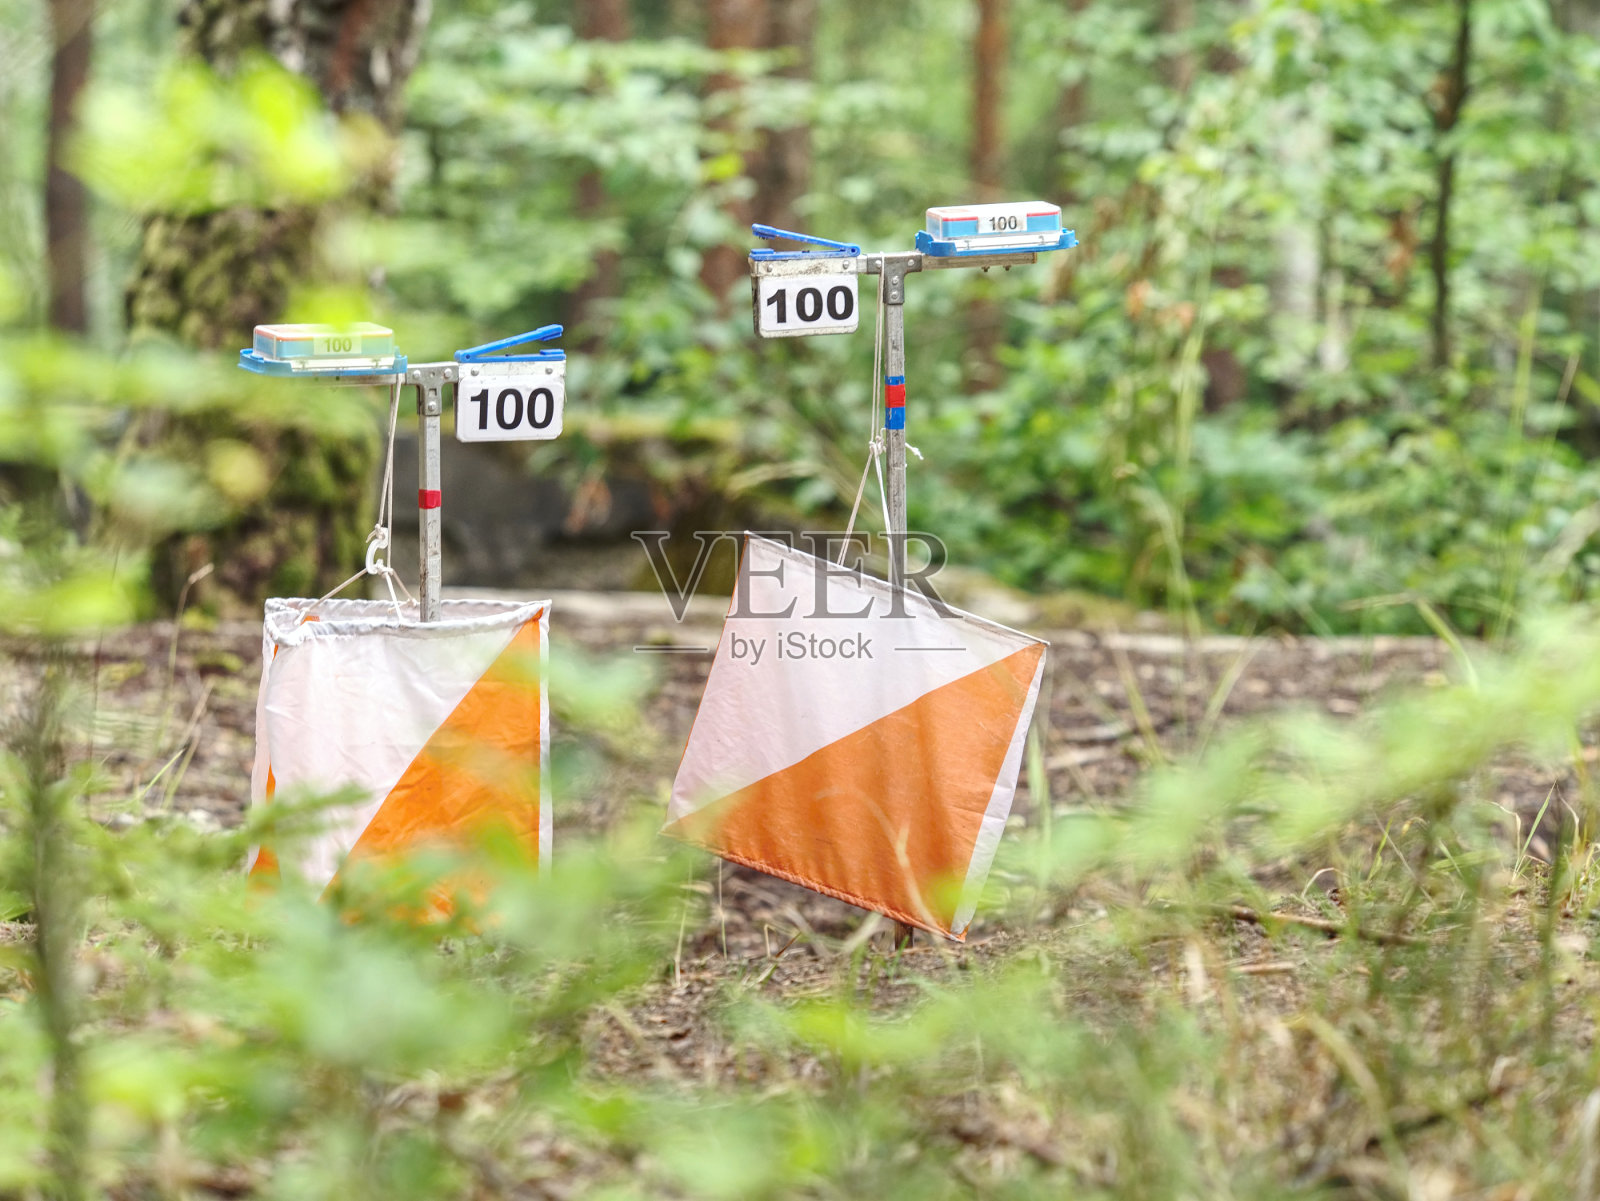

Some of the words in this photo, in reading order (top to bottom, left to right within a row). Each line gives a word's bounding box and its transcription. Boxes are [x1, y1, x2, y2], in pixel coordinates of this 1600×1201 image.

[989, 215, 1018, 231] 100
[766, 285, 854, 324] 100
[323, 337, 352, 353] 100
[470, 387, 555, 431] 100
